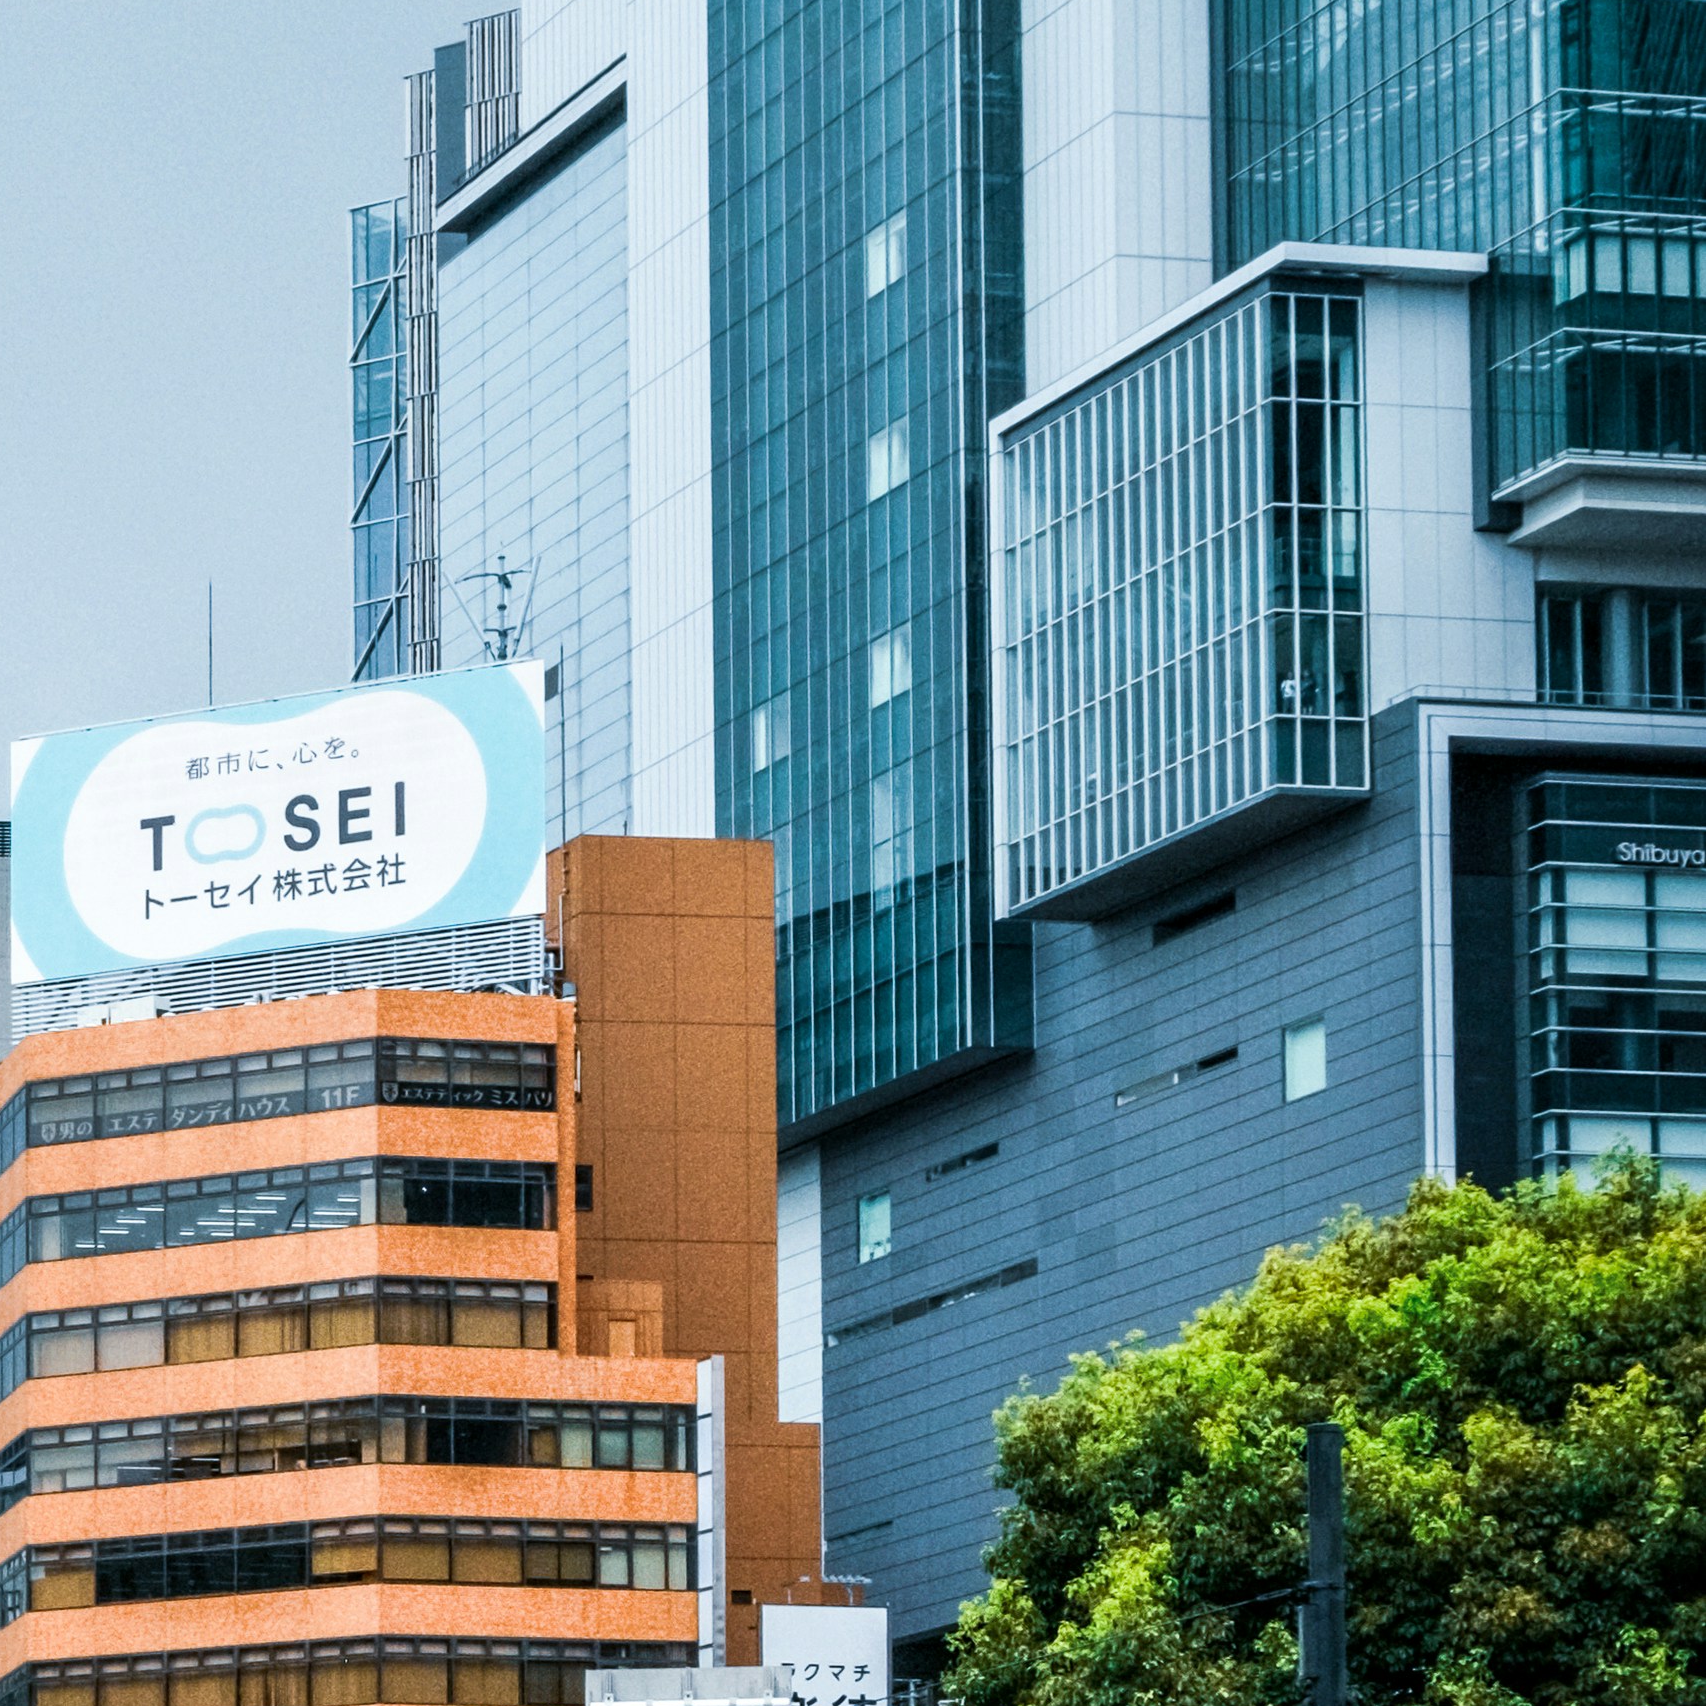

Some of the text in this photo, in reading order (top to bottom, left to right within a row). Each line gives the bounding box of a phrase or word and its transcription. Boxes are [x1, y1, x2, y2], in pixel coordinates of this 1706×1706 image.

[185, 735, 361, 781] 都市に、心を。
[138, 780, 407, 872] TOSEI
[1615, 841, 1706, 869] Shibuya
[143, 854, 408, 921] トーセイ株式会社
[320, 1085, 360, 1109] 11F
